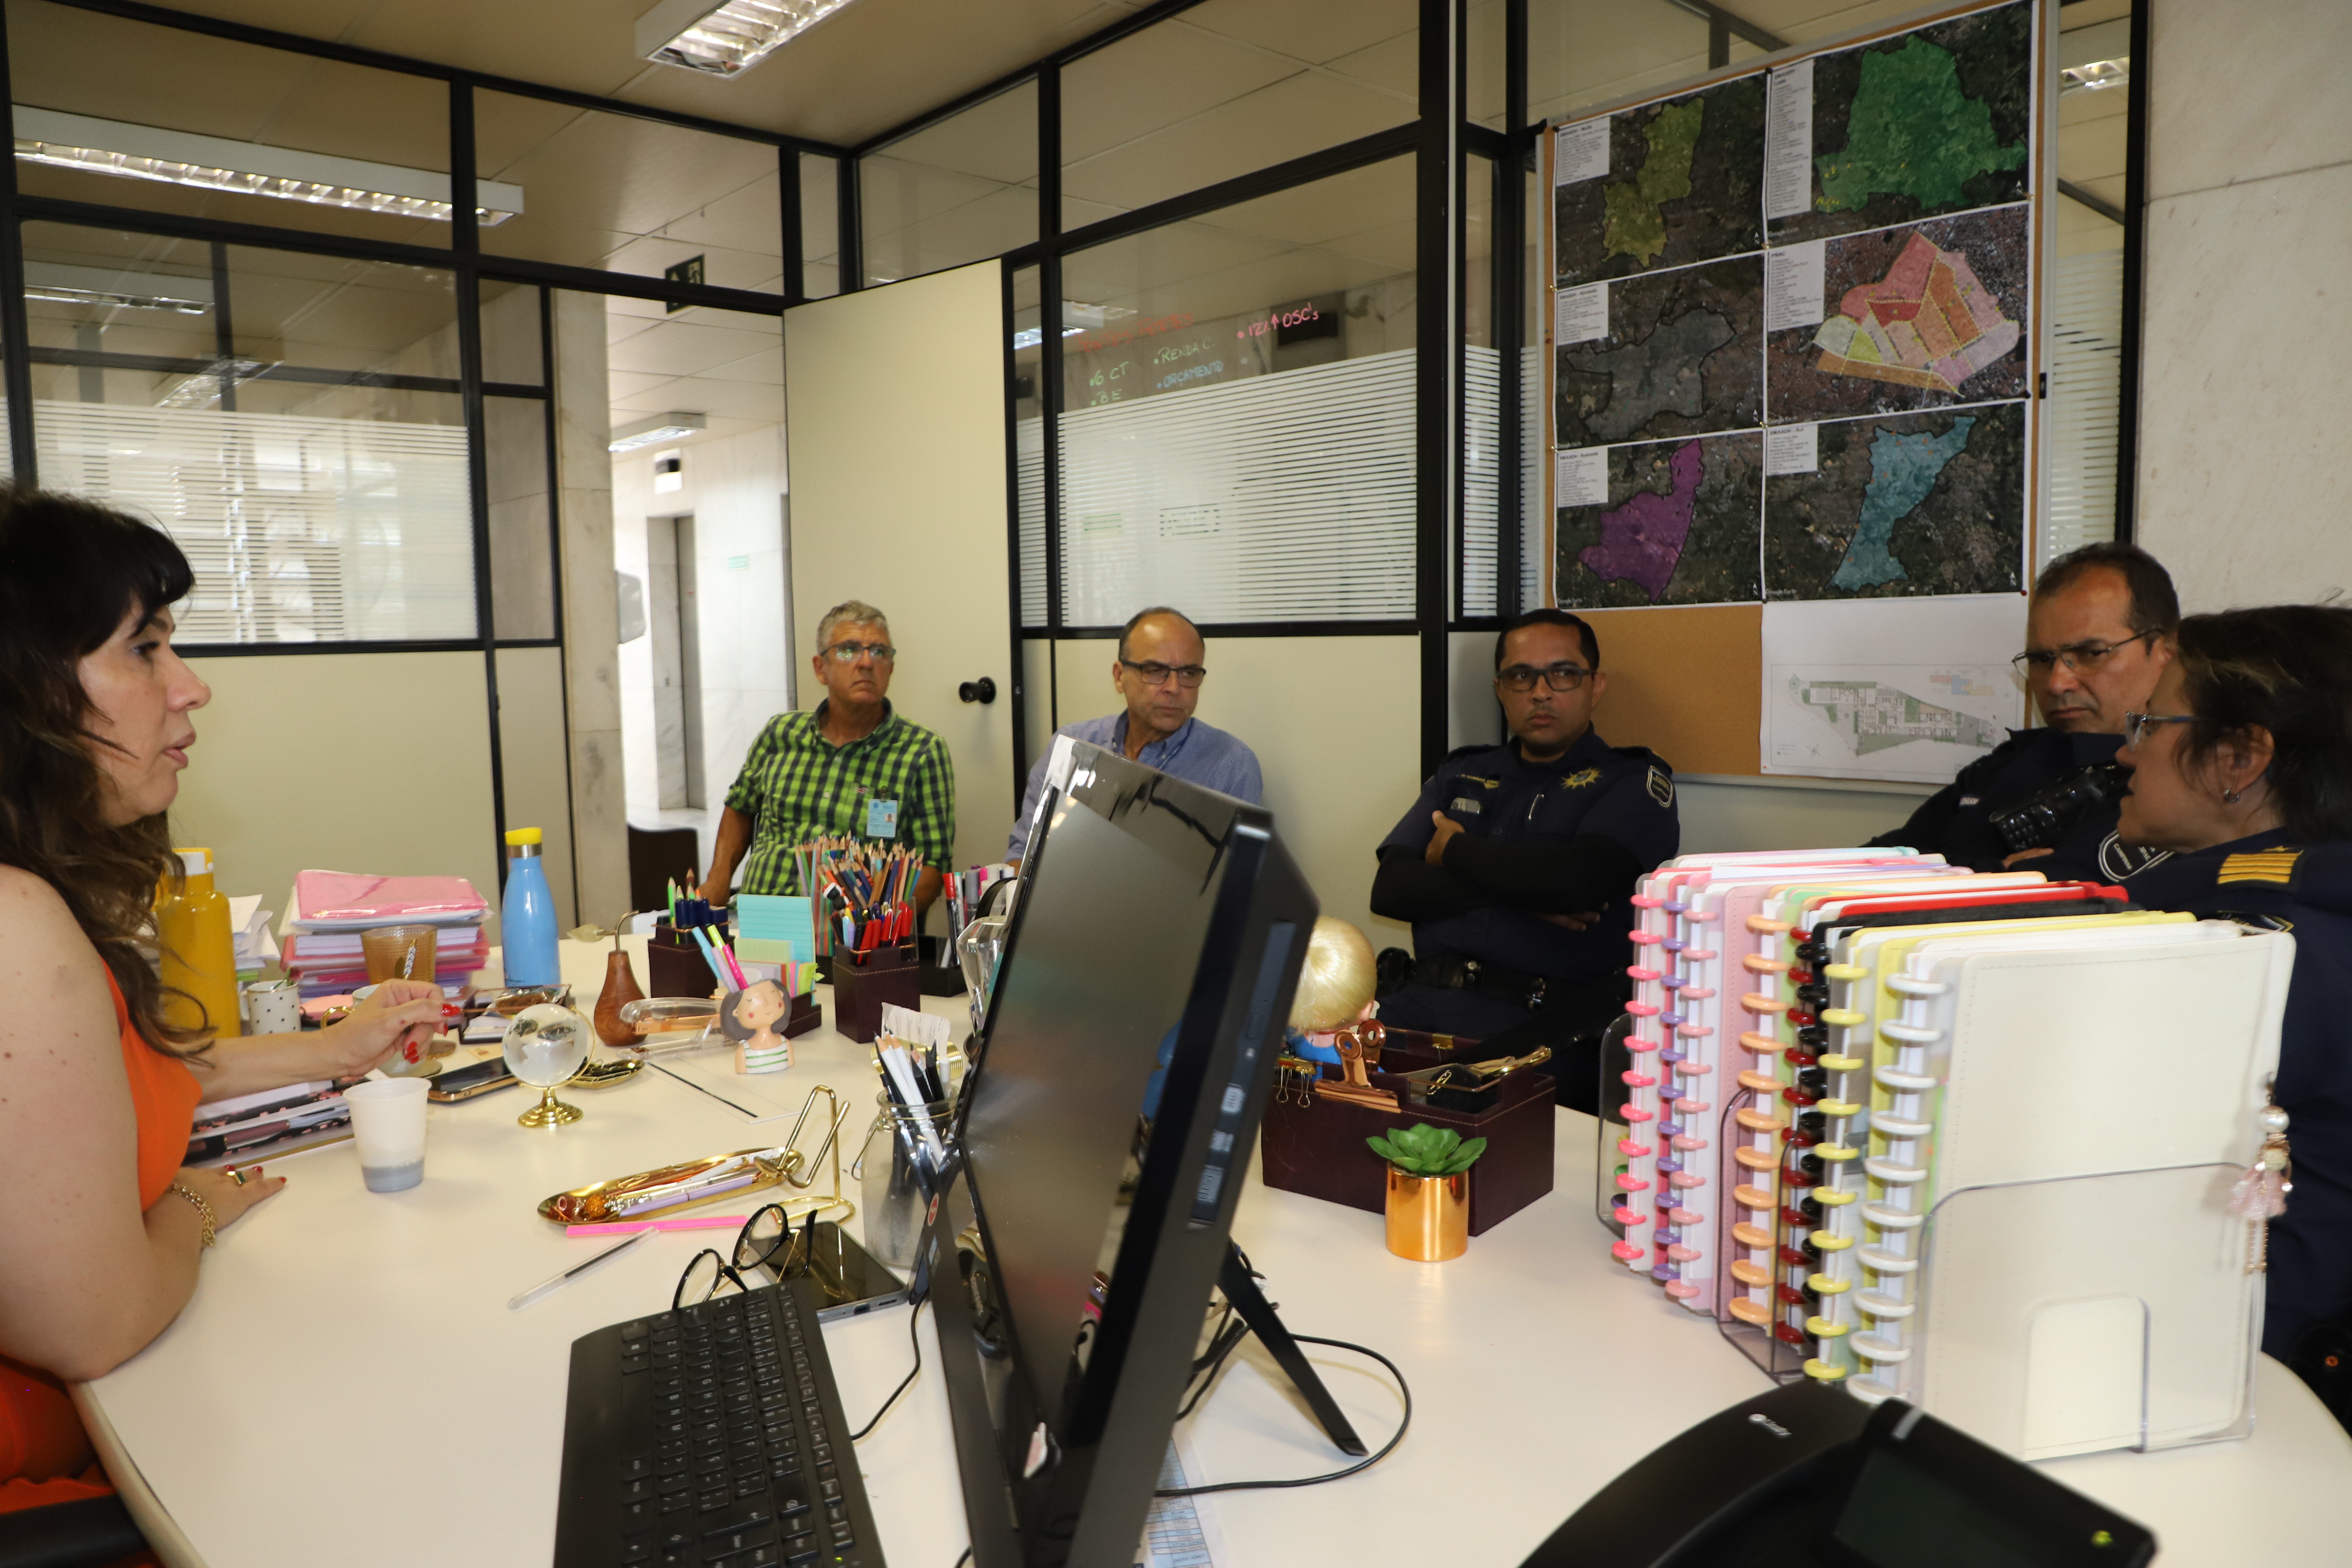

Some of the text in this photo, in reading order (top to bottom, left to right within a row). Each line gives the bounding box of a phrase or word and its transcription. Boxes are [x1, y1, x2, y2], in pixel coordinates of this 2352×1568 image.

[1137, 313, 1193, 337] FORTES
[1158, 342, 1200, 363] RENDA
[2114, 843, 2133, 870] CAMPINAS
